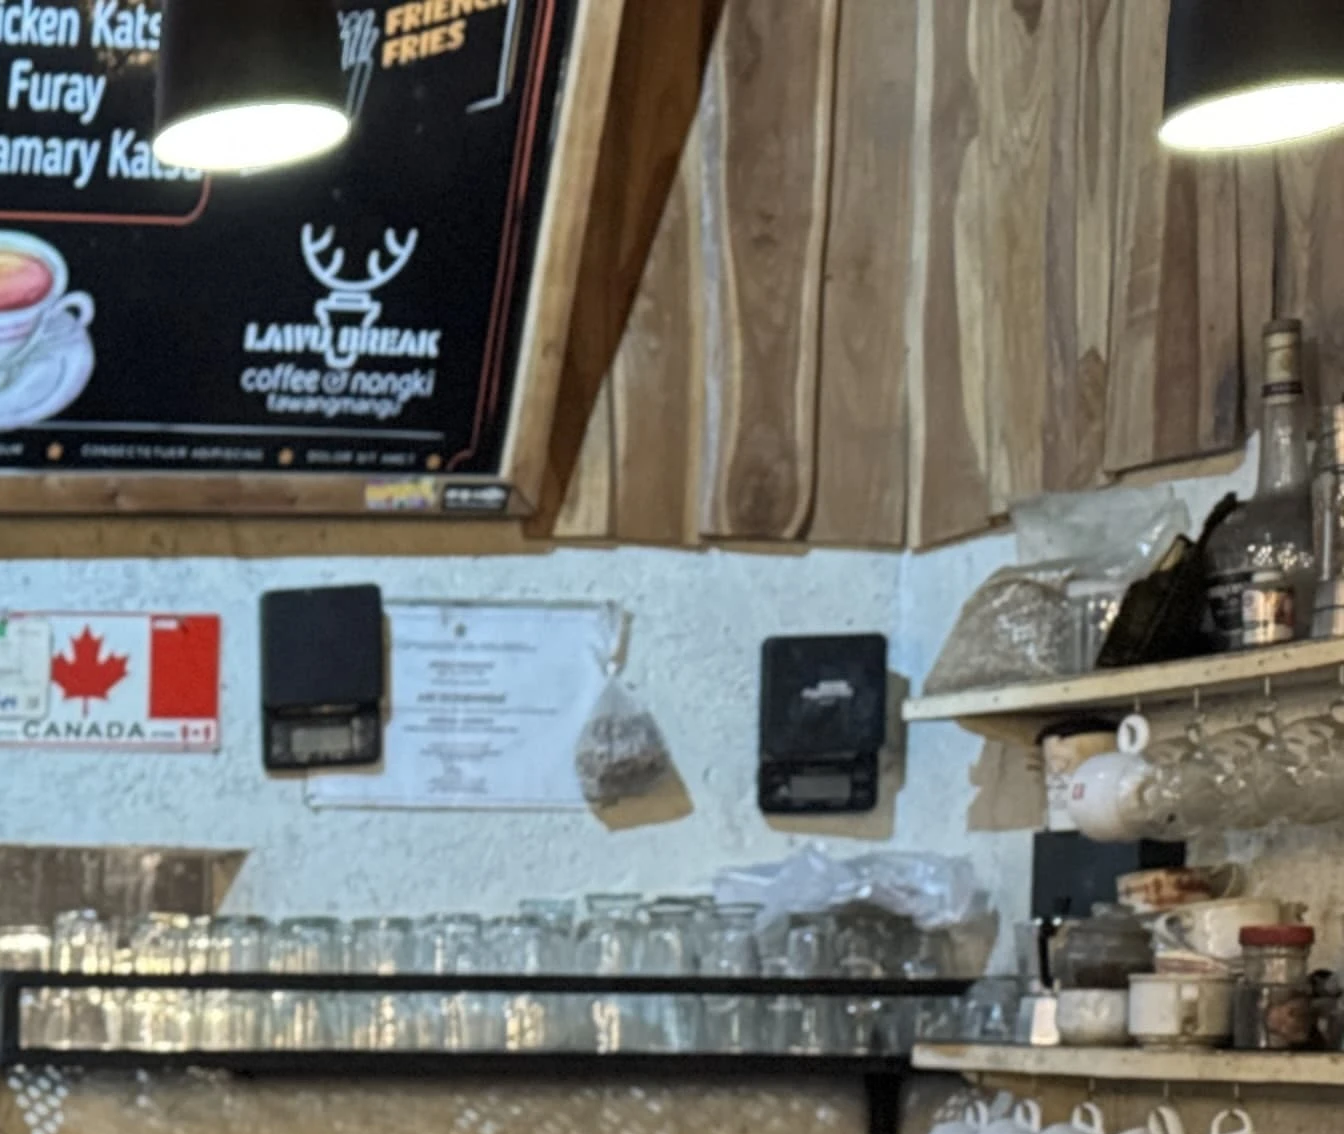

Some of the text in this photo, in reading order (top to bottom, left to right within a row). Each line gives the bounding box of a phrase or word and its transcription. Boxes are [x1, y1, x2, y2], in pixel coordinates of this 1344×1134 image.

[91, 0, 161, 50] Kats
[382, 18, 467, 69] FRIES
[8, 58, 107, 125] Furay
[107, 127, 203, 182] Kat
[244, 322, 442, 358] LAWU BREAK
[241, 363, 320, 392] coffee
[350, 368, 436, 403] nongki
[23, 720, 145, 739] CANADA
